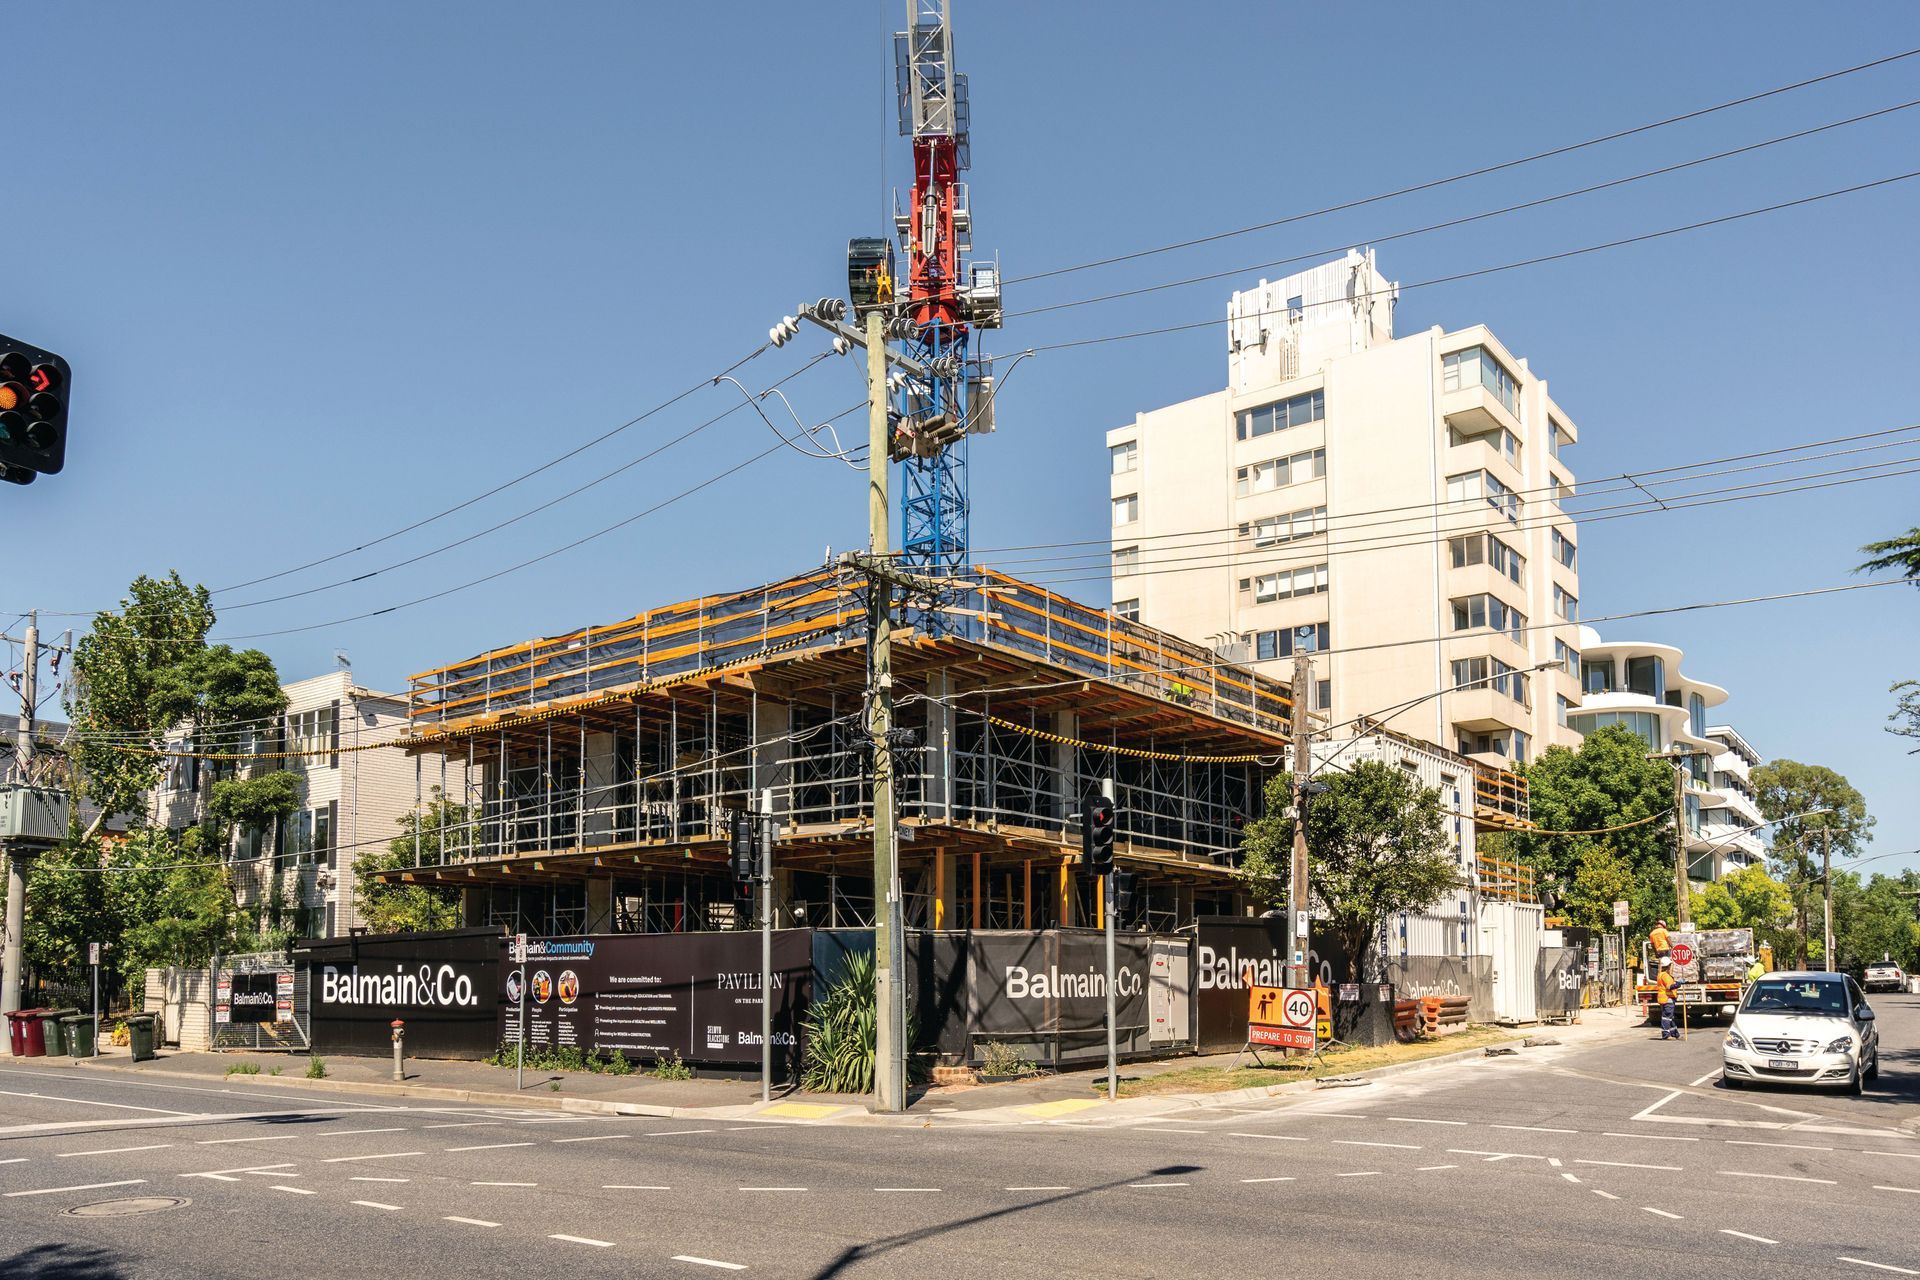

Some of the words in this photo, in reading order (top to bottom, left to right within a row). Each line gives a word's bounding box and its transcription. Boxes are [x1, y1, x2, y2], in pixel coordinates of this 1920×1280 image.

[1672, 950, 1691, 961] STOP
[322, 964, 478, 1006] Balmain&Co.
[717, 972, 783, 990] PAVILIN
[234, 991, 274, 1005] Balmain&Co.
[1288, 1000, 1309, 1017] 40
[1252, 1030, 1281, 1041] PREPARE
[1283, 1033, 1292, 1043] TO
[1295, 1034, 1313, 1045] STOP
